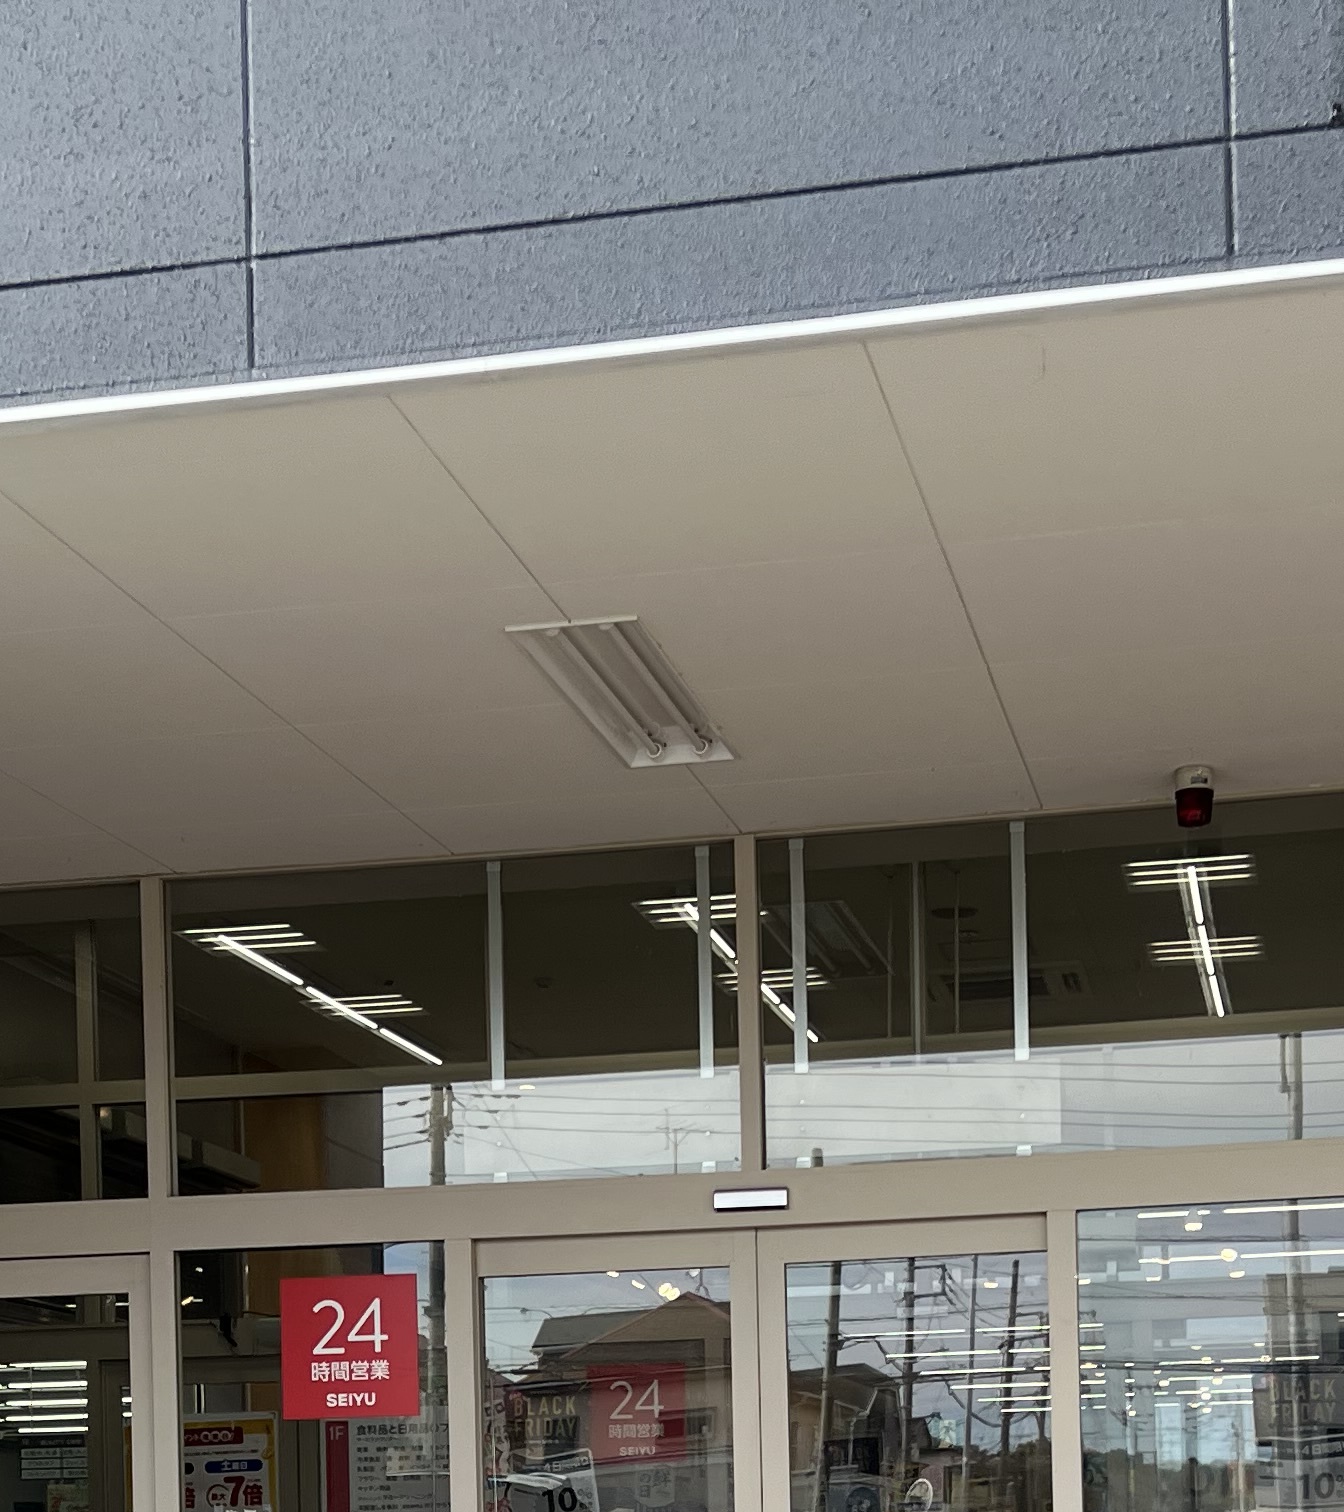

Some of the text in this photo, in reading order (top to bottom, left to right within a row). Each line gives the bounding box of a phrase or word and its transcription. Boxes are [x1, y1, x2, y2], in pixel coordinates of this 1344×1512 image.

[313, 1297, 388, 1355] 24
[311, 1360, 390, 1382] 時間営業
[326, 1393, 376, 1407] SEIYU
[609, 1379, 664, 1420] 24
[1269, 1378, 1336, 1401] BLACK
[514, 1395, 576, 1416] BLACK
[514, 1416, 576, 1439] FRIDAY
[608, 1424, 664, 1439] 時間営業
[619, 1446, 655, 1456] SEIYU
